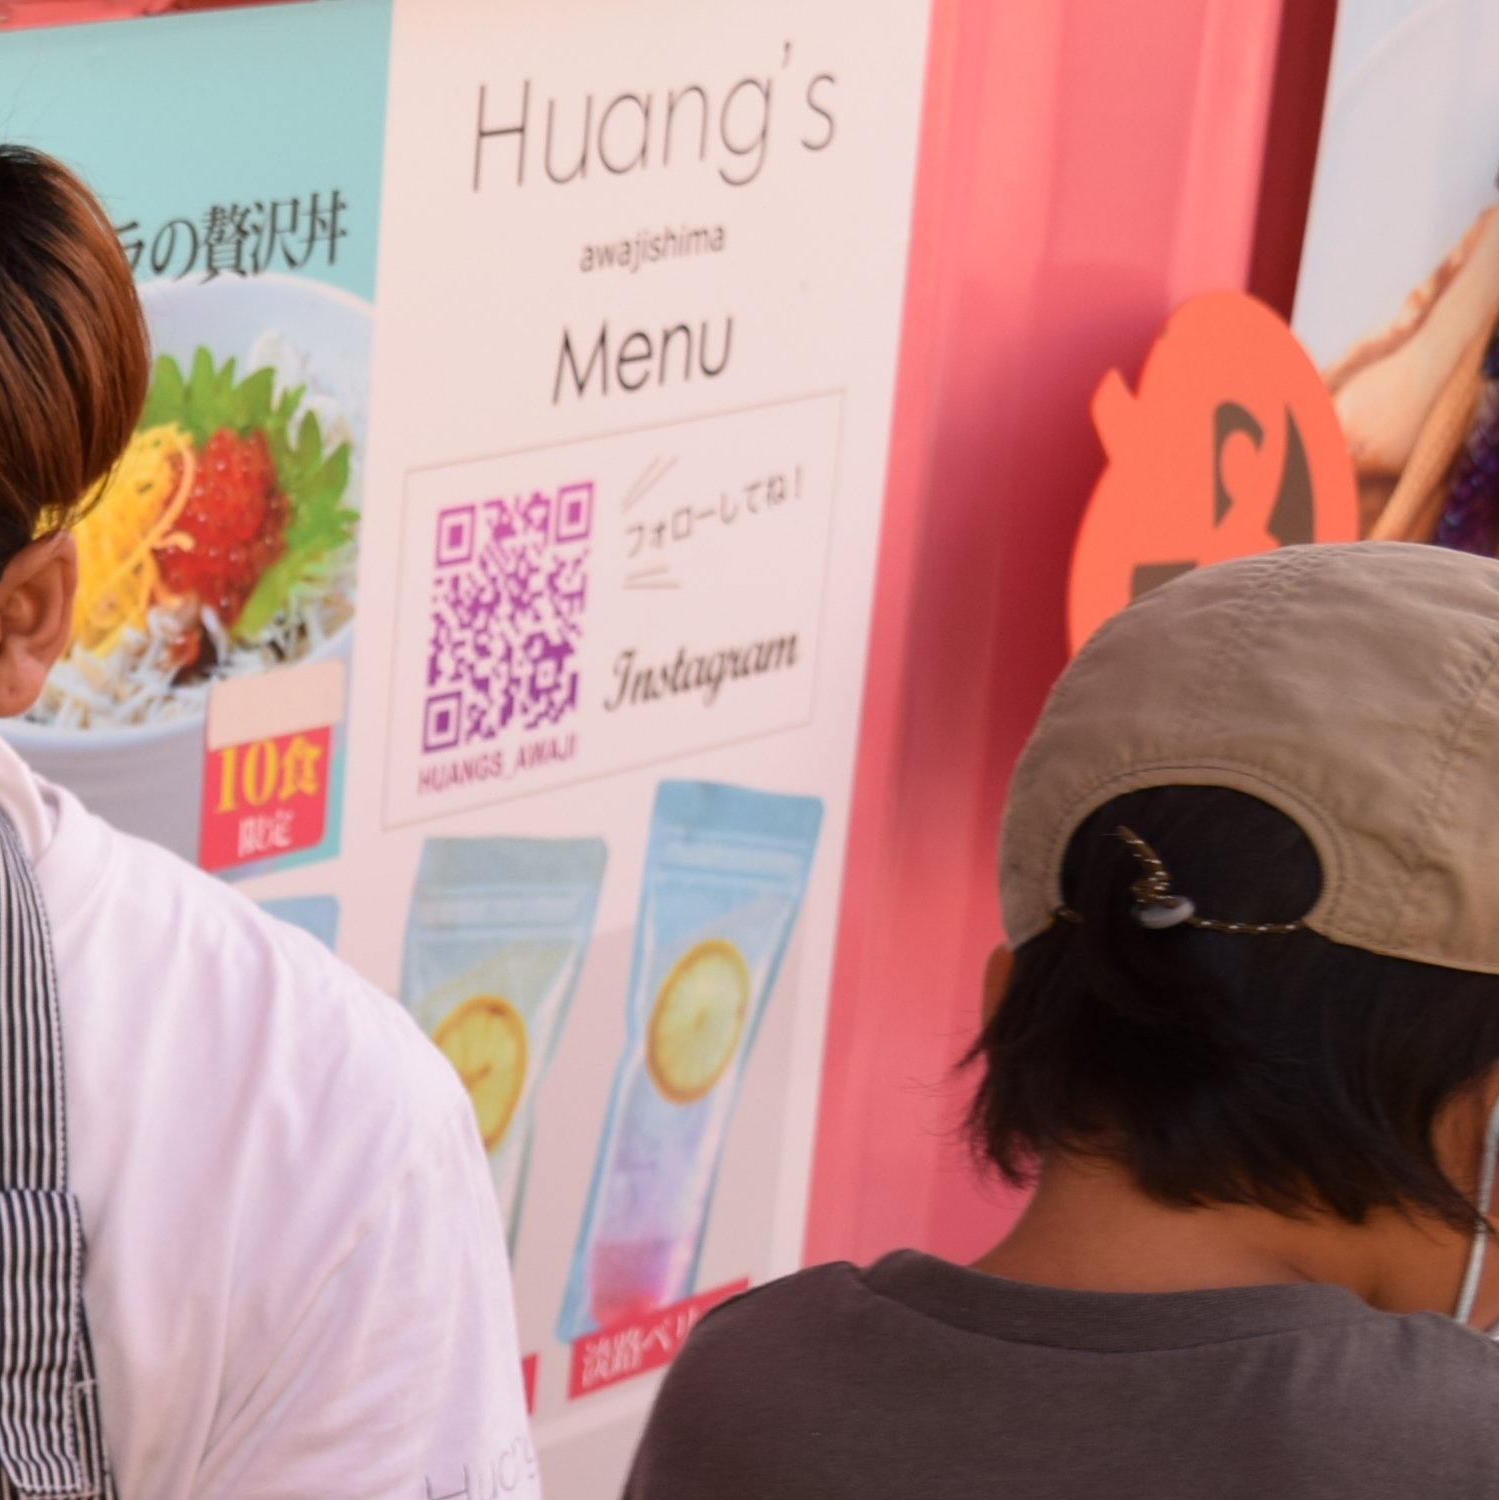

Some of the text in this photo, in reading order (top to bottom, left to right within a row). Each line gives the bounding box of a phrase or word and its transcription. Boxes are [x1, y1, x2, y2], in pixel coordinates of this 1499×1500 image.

[473, 39, 837, 193] Huang's
[578, 225, 727, 274] awajishima
[552, 316, 734, 406] Menu
[602, 631, 800, 713] Instagram
